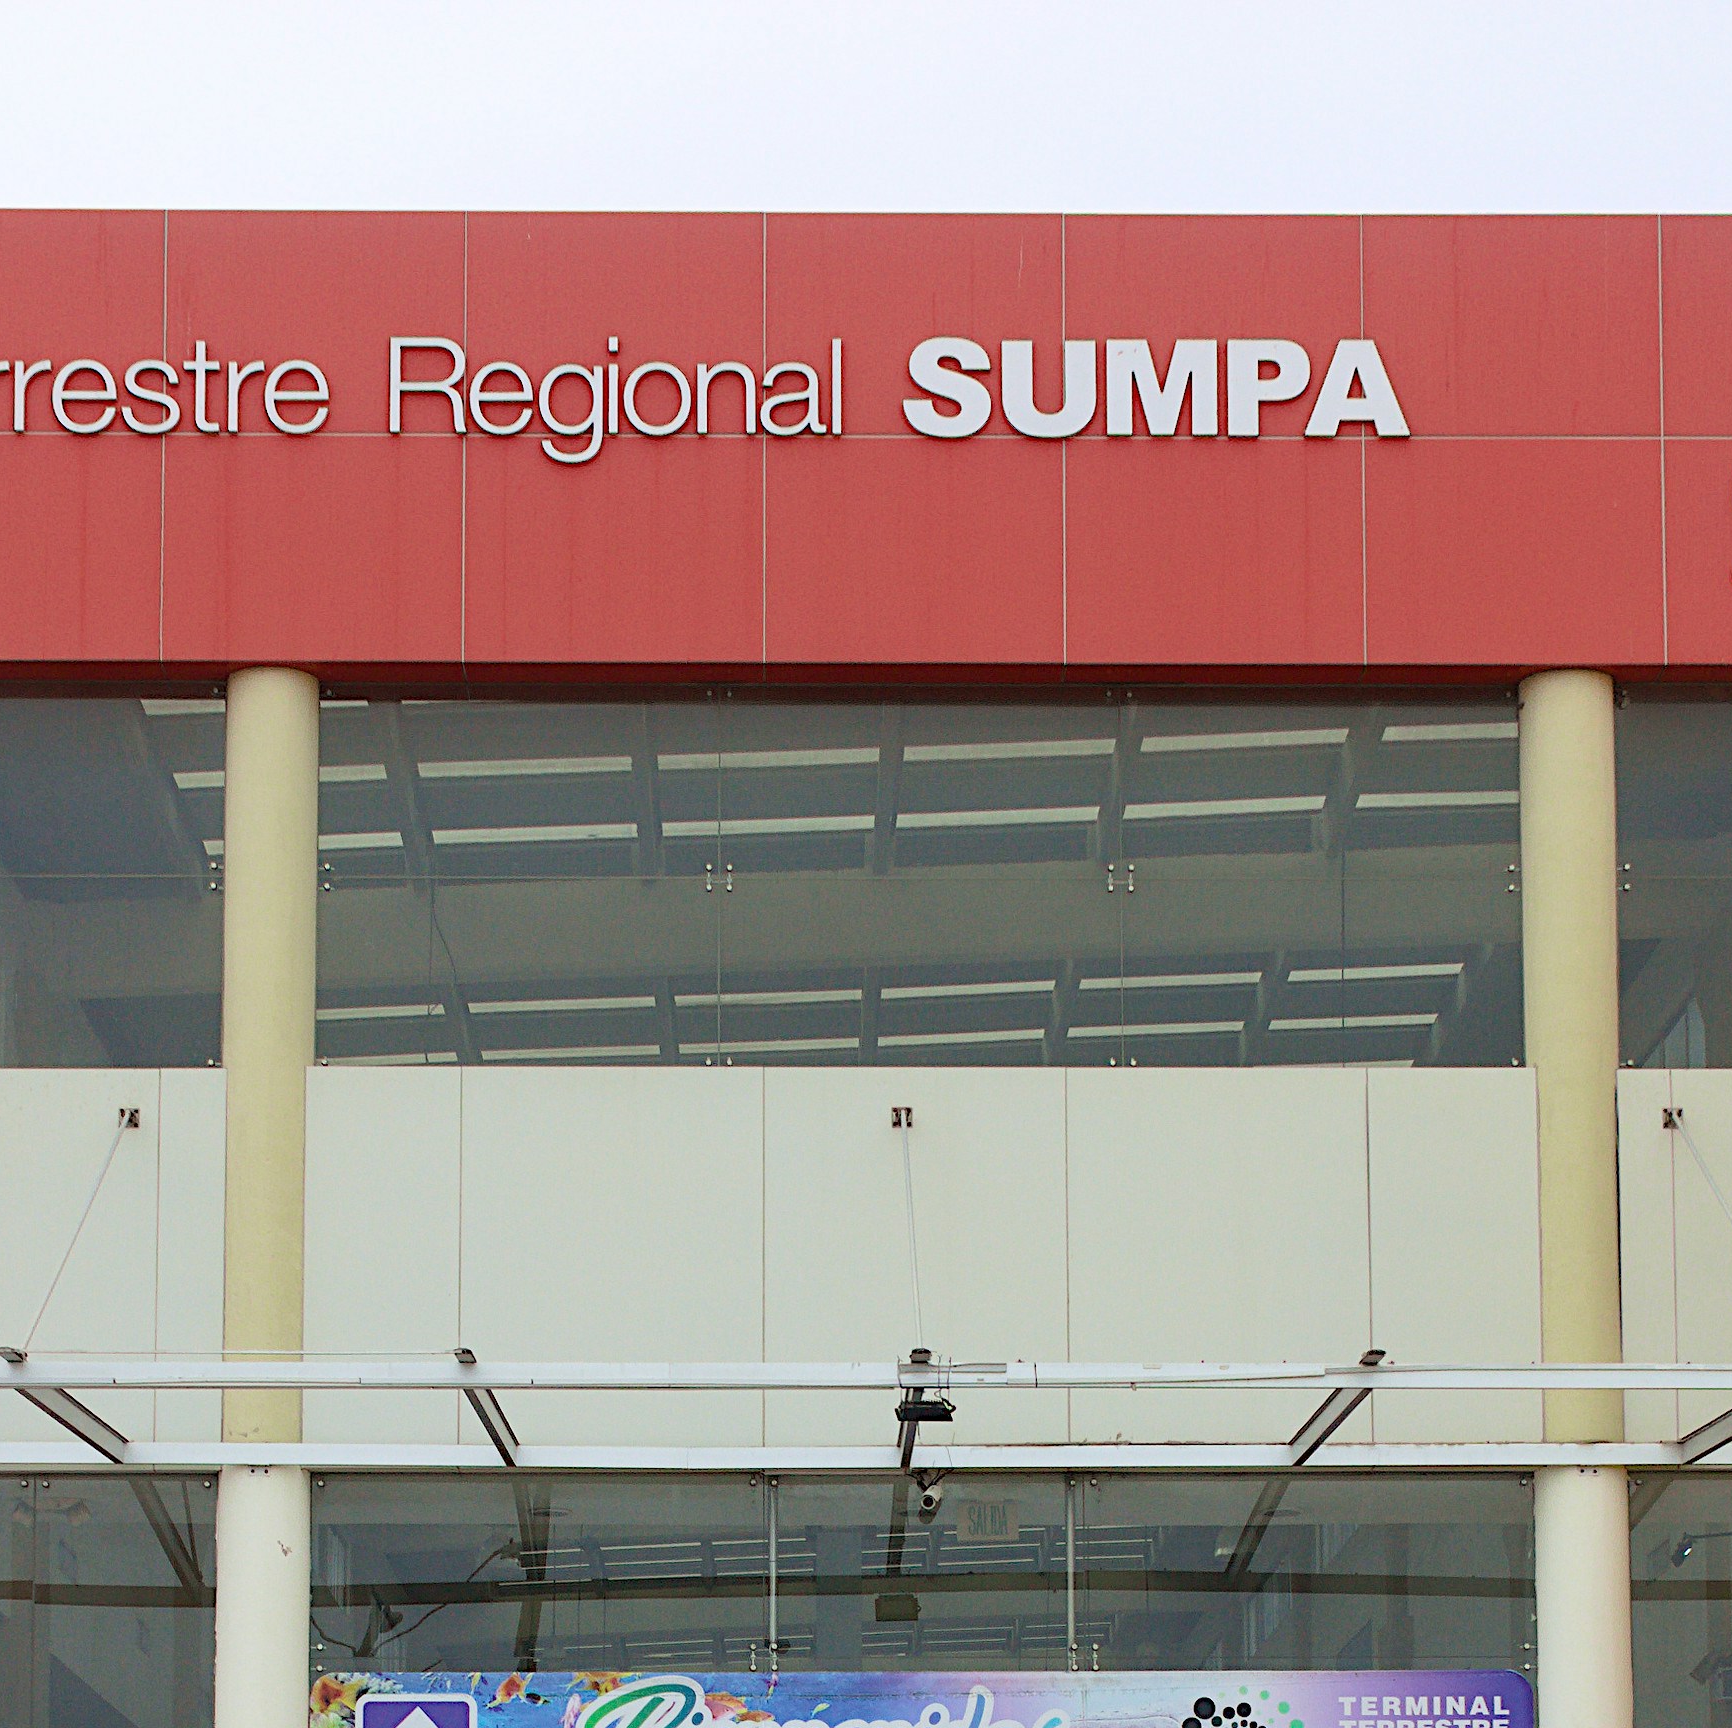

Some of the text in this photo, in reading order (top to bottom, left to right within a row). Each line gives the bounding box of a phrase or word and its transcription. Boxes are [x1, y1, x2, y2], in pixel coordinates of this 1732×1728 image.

[388, 335, 843, 465] Regional
[901, 336, 1412, 439] SUMPA
[1337, 1695, 1511, 1716] TERMINAL
